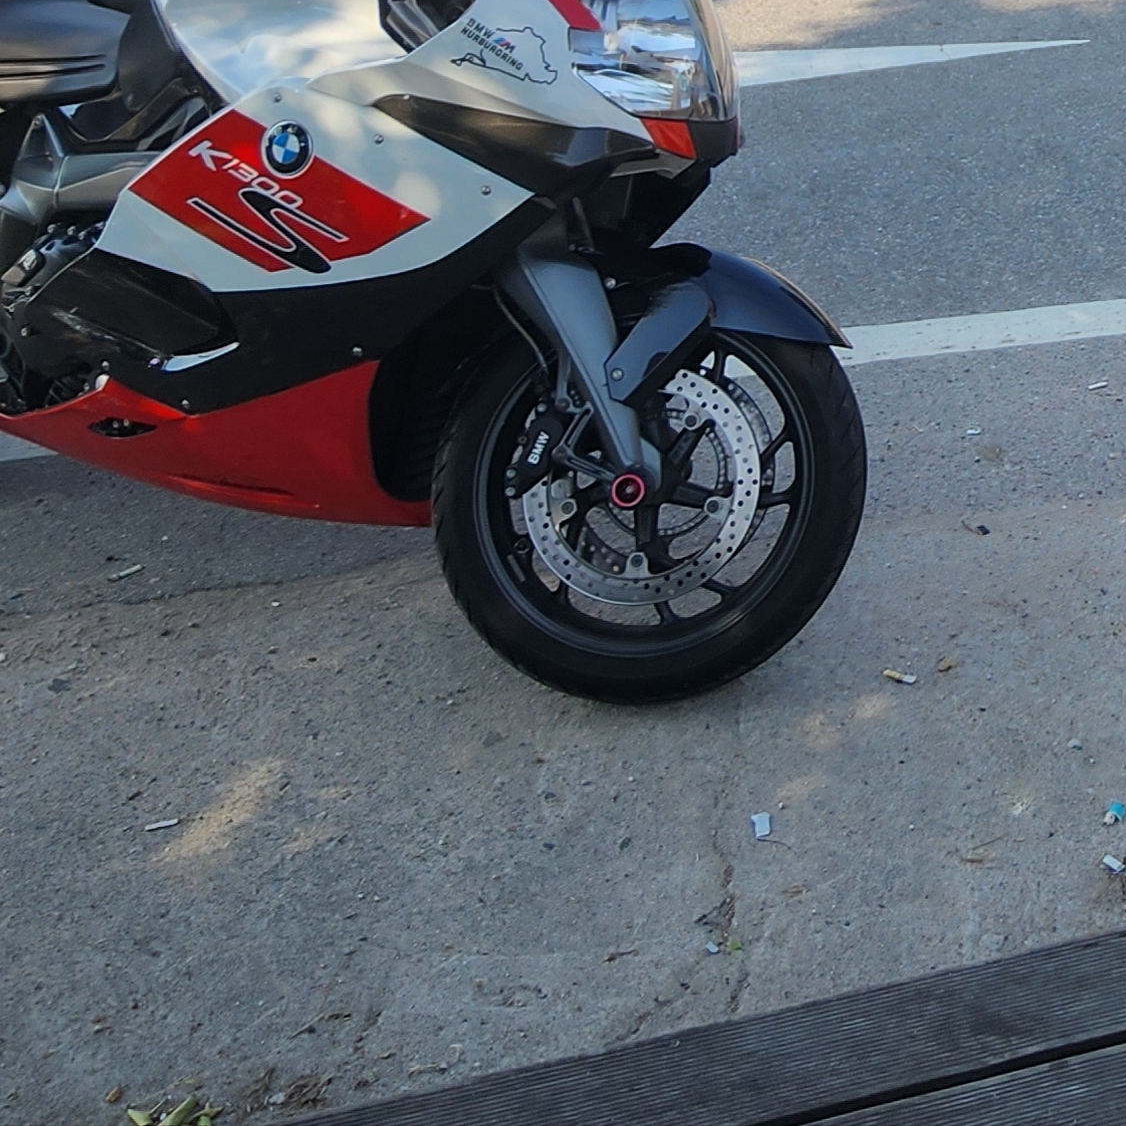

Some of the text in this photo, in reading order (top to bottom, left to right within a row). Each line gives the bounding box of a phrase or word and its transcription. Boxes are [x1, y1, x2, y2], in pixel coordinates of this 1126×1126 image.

[465, 17, 496, 39] BMW
[460, 26, 524, 71] NURBURGRING
[527, 431, 550, 465] BMW
